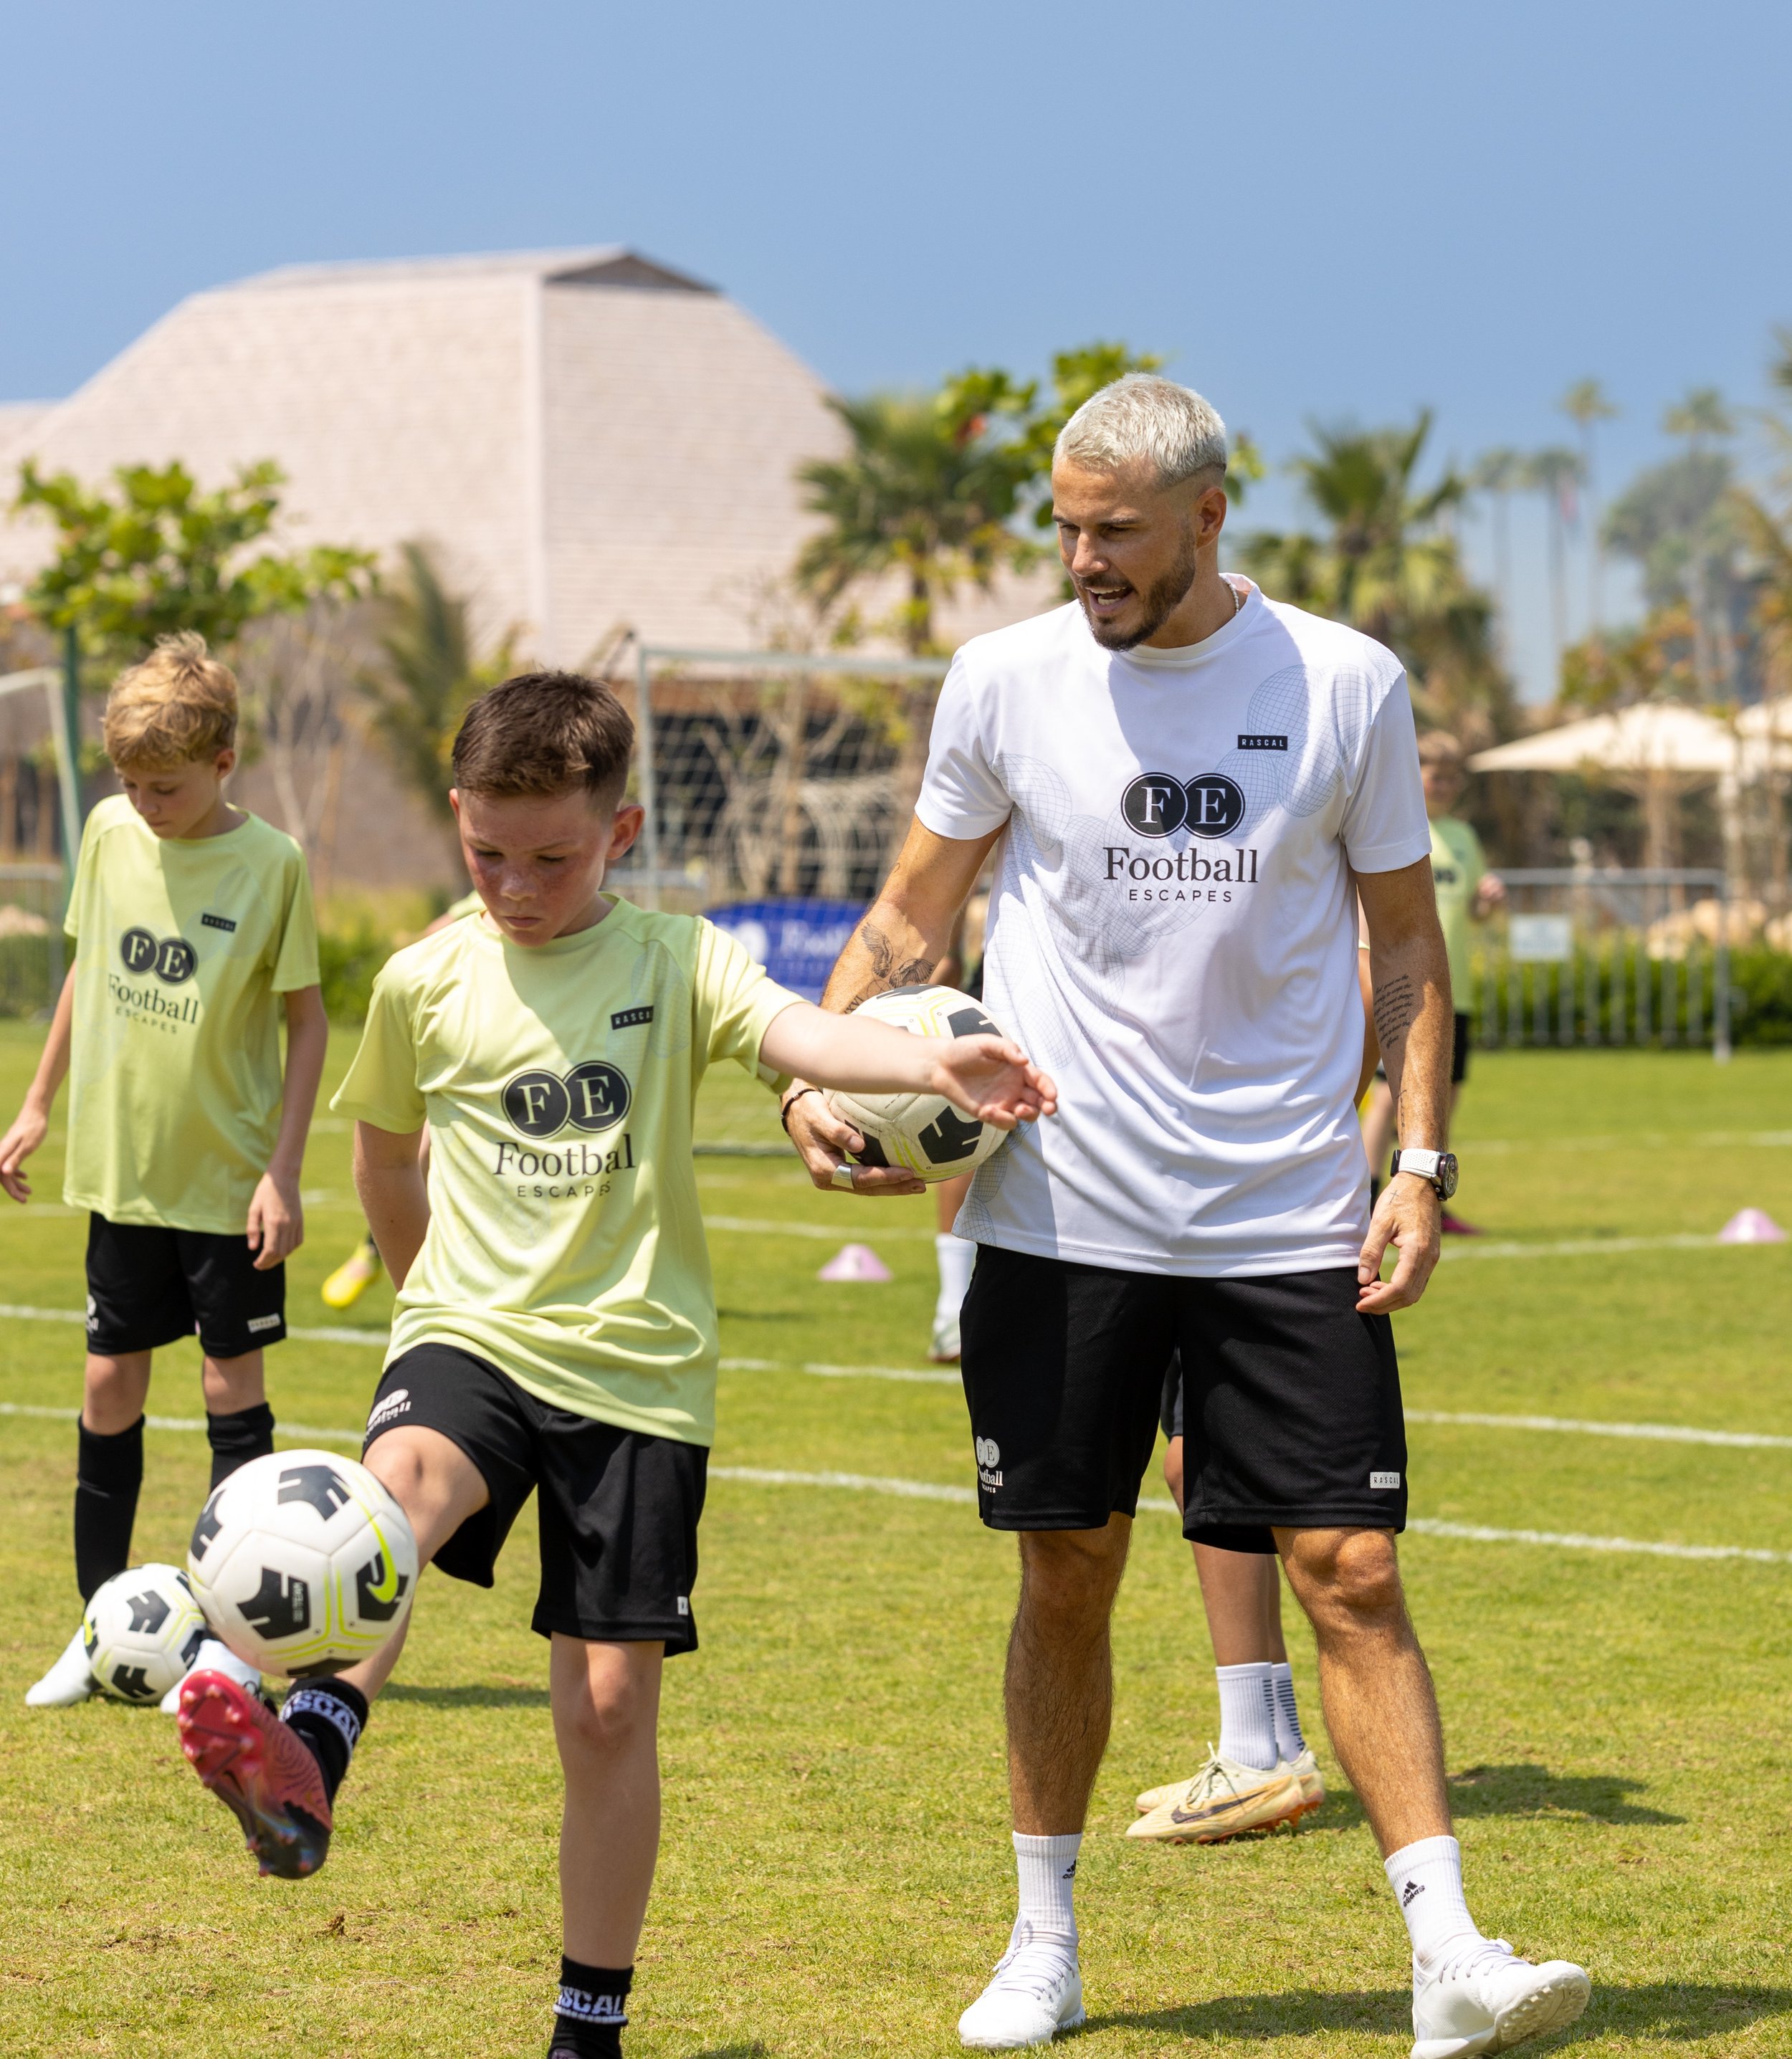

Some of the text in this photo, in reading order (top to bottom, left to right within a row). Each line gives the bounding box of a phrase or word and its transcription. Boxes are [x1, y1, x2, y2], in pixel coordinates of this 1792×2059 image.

[1241, 738, 1285, 747] RASCAL
[1102, 847, 1259, 883] Football
[1129, 889, 1232, 902] ESCAPES
[108, 973, 199, 1025] Football
[115, 1005, 178, 1035] ESCAPES
